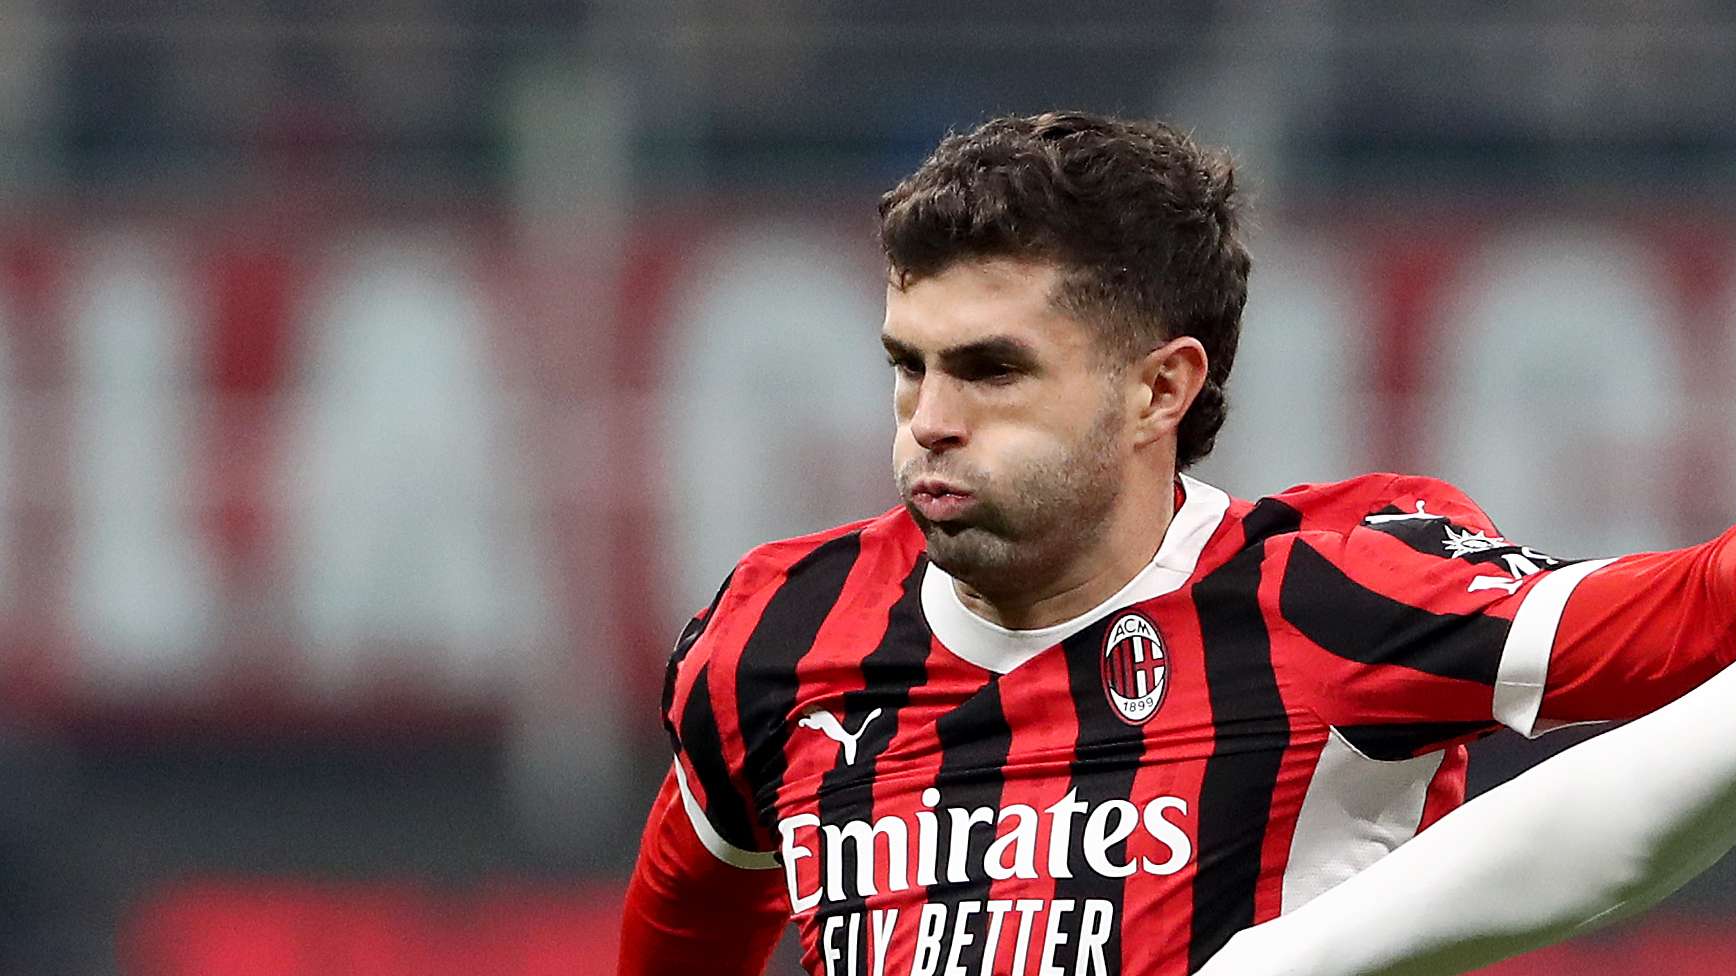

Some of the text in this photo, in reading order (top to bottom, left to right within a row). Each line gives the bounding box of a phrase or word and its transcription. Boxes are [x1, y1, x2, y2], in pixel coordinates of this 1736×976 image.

[1113, 618, 1151, 642] ACM
[1123, 697, 1154, 713] 1899
[777, 786, 1193, 914] Emirates
